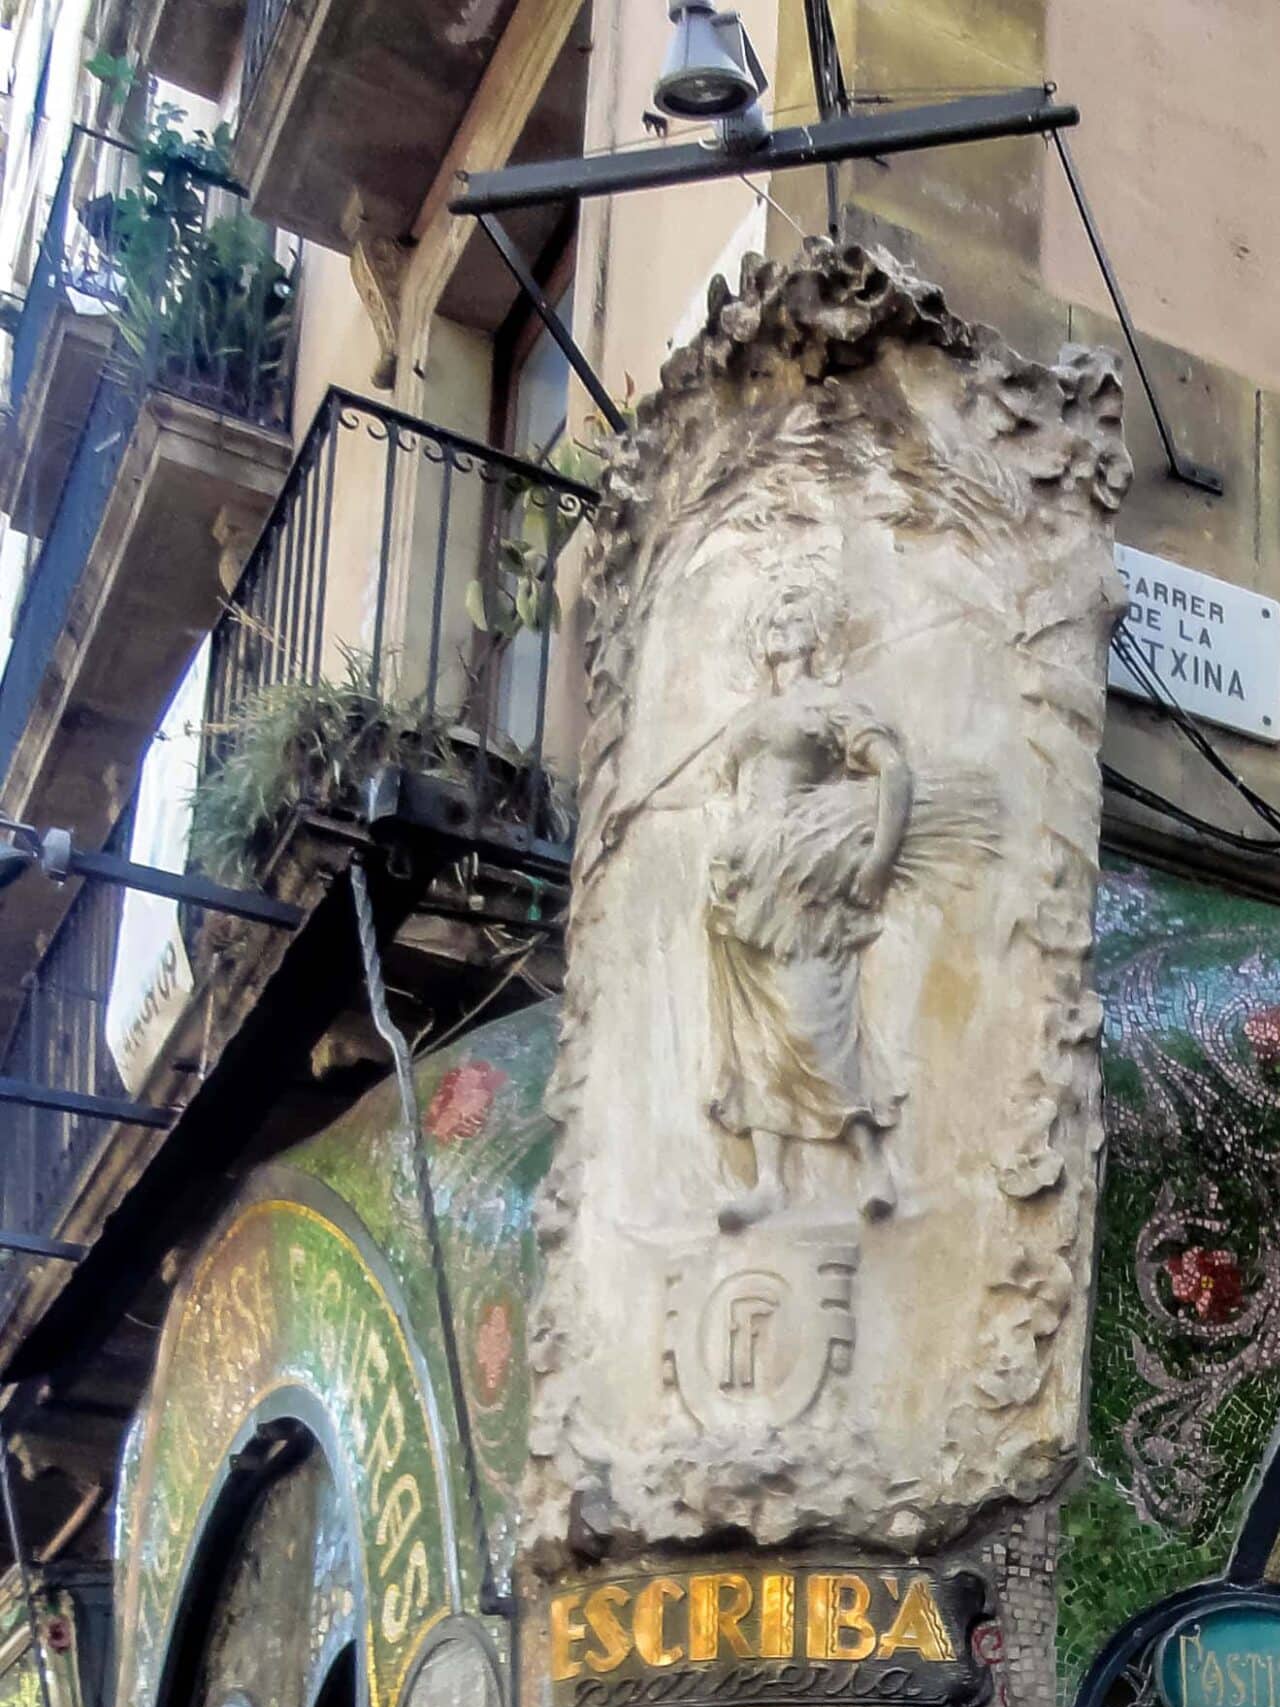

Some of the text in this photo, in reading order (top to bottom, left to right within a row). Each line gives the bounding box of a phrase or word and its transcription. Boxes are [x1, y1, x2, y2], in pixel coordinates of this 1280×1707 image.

[1127, 600, 1212, 649] DE LA
[1117, 632, 1246, 700] TXINA
